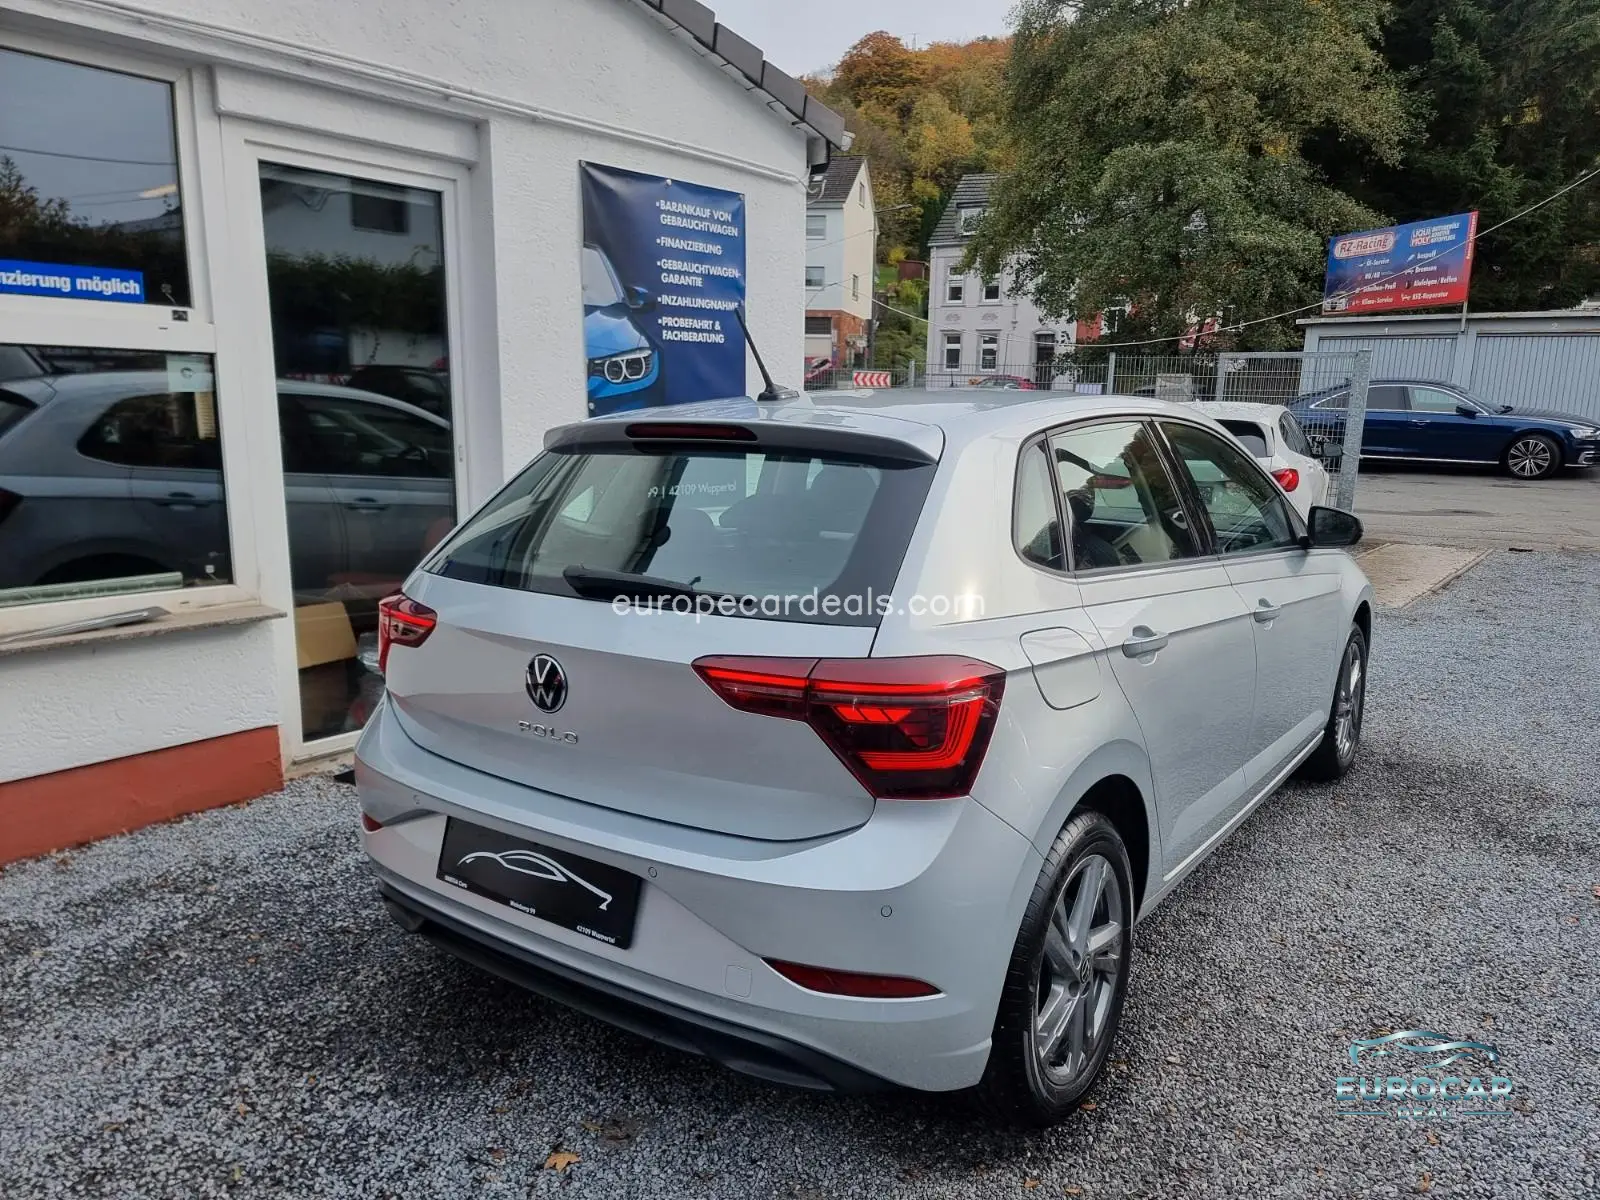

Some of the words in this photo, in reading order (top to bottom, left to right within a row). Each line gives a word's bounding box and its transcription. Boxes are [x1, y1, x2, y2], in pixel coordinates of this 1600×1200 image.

[660, 200, 711, 219] BARANKAUF
[713, 209, 732, 222] VON
[660, 214, 738, 237] GEBRAUCHTWAGEN
[660, 237, 722, 255] FINANZIERUNG
[1340, 236, 1389, 253] RZ-Racing
[661, 259, 741, 278] GEBRAUCHTWAGEN-
[76, 276, 140, 295] möglich
[661, 273, 703, 287] GARANTIE
[662, 316, 712, 330] PROBEFAHRT
[714, 320, 721, 330] &
[662, 330, 724, 344] FACHBERATUNG
[668, 483, 697, 497] 42109
[518, 720, 578, 744] POLO
